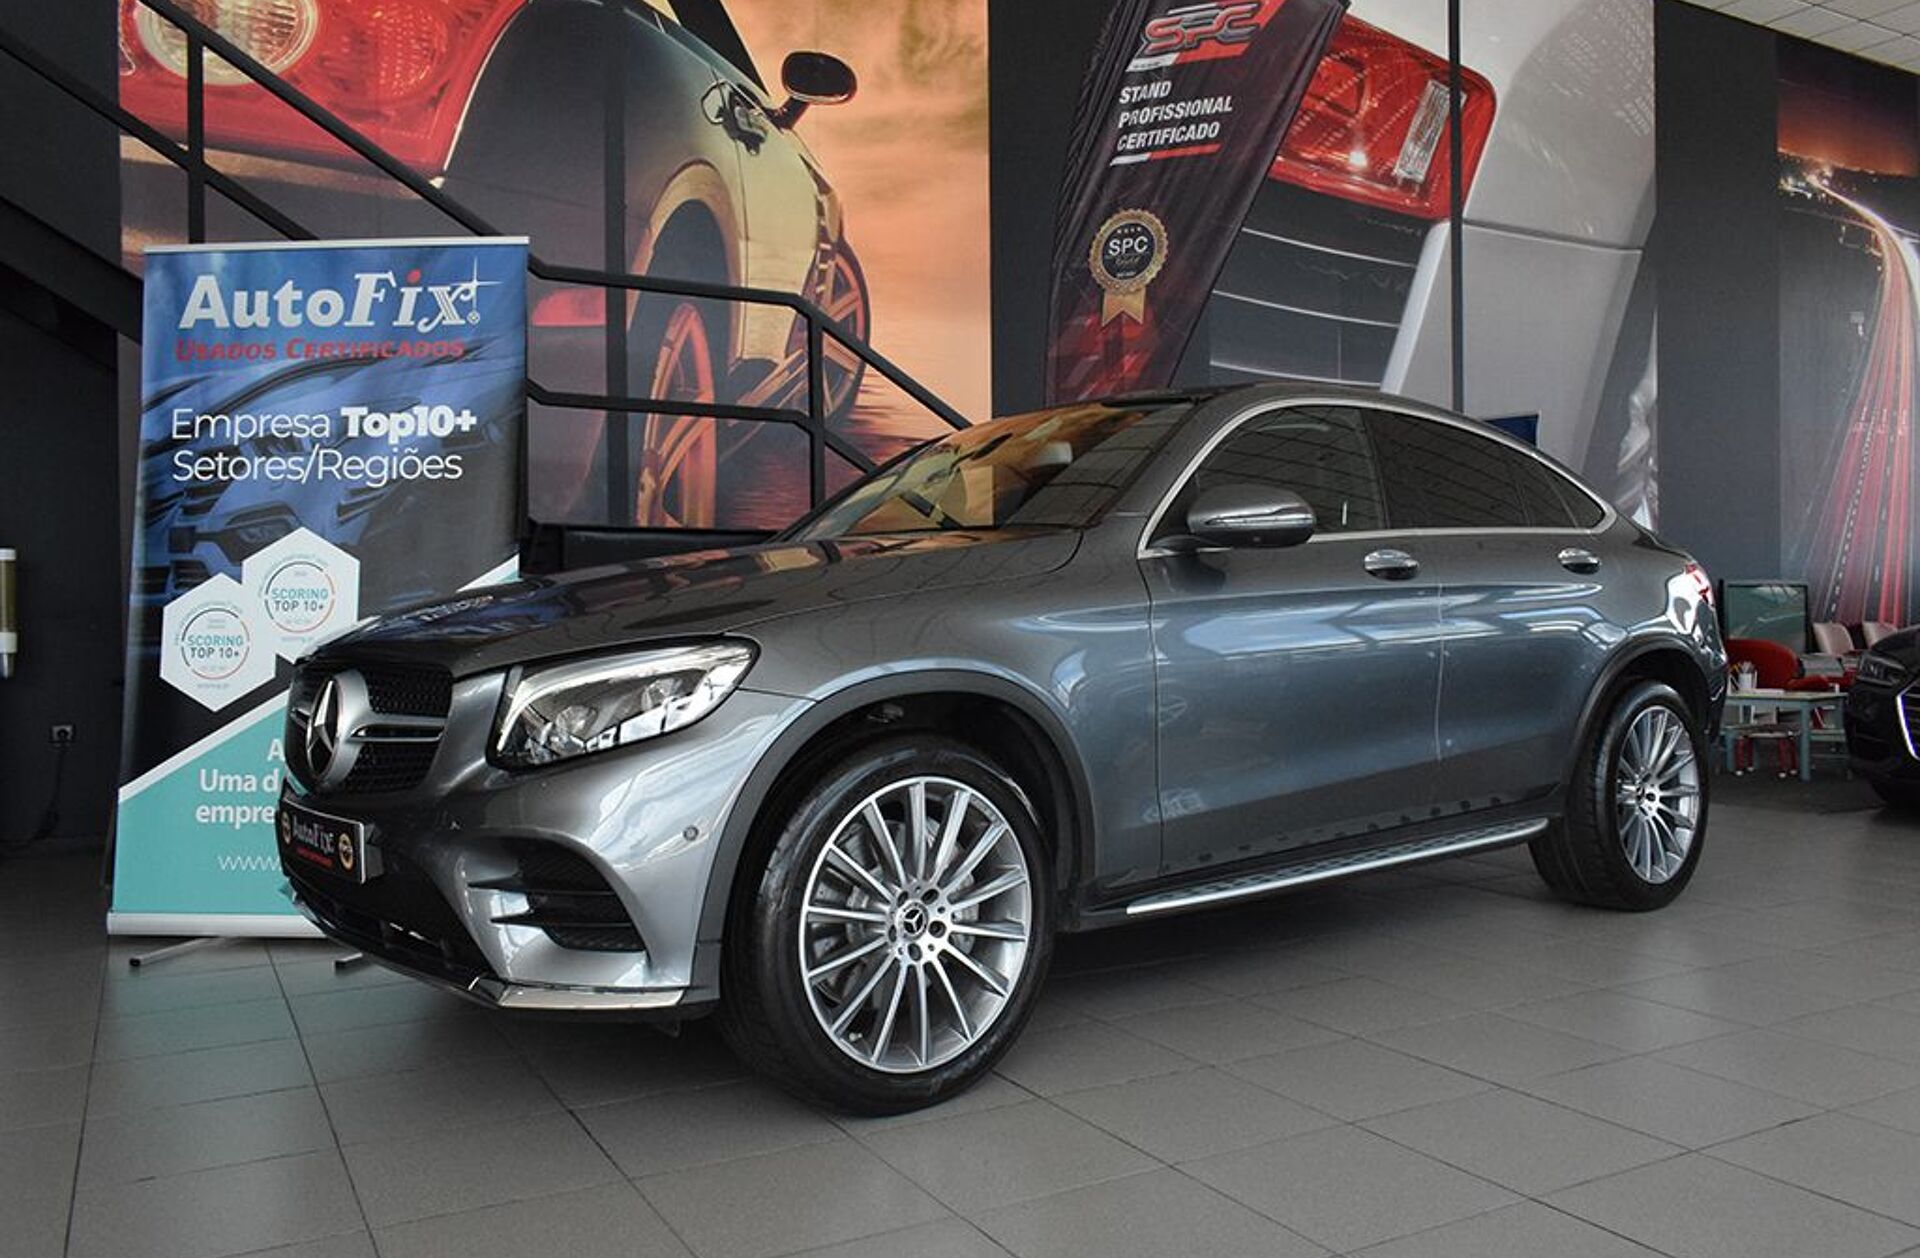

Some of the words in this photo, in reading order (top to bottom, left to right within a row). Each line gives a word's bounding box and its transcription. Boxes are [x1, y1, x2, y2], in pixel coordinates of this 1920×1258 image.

[1119, 81, 1172, 104] STAND
[1118, 95, 1233, 129] PROFISSIONAL
[1117, 121, 1221, 151] CERTIFICADO
[1108, 236, 1148, 256] SPC
[179, 270, 478, 332] AutoFix
[172, 408, 330, 445] Empresa
[341, 405, 477, 444] Top10+
[172, 443, 463, 487] Setores/Regiões
[272, 588, 328, 600] SCORING
[274, 600, 299, 612] TOP
[187, 635, 244, 647] SCORING
[191, 647, 214, 659] TOP
[199, 769, 257, 793] Uma
[195, 804, 277, 830] empre
